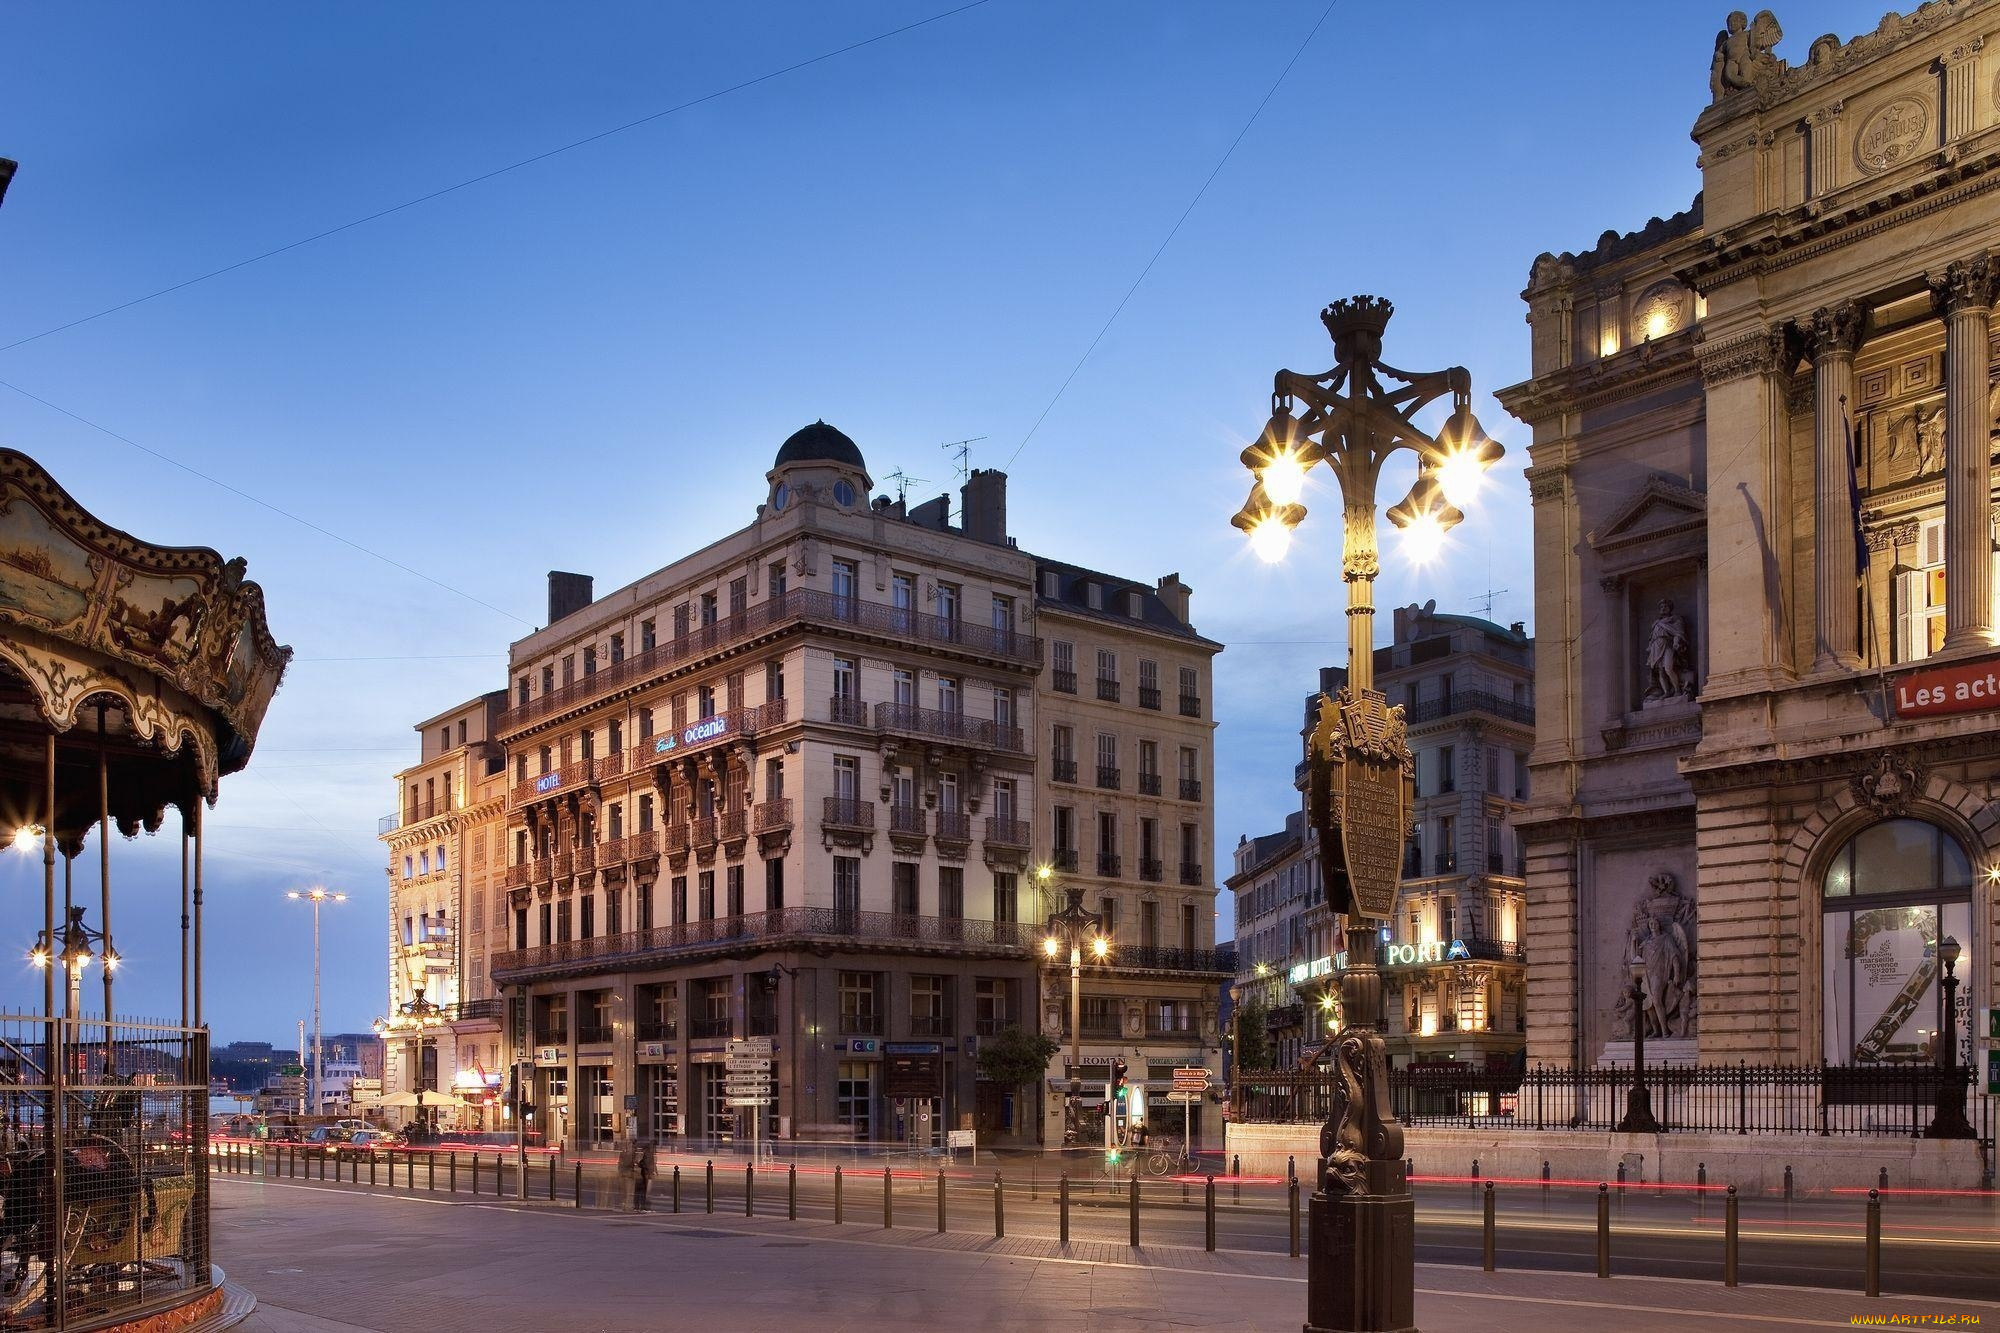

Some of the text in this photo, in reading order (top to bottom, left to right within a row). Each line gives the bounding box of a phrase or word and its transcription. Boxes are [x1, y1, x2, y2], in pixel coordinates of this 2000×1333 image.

[1900, 686, 1946, 709] Les
[685, 716, 726, 743] oceania
[537, 774, 560, 792] HOTEL
[1364, 762, 1380, 783] ICI
[1349, 797, 1358, 808] LE
[1346, 808, 1391, 829] ALEXANDRE
[1355, 824, 1399, 841] YOUGOSLAVIE
[1388, 941, 1446, 965] PORT
[1310, 955, 1333, 978] HOTEL
[1335, 950, 1349, 970] VIE
[1864, 962, 1899, 971] provence
